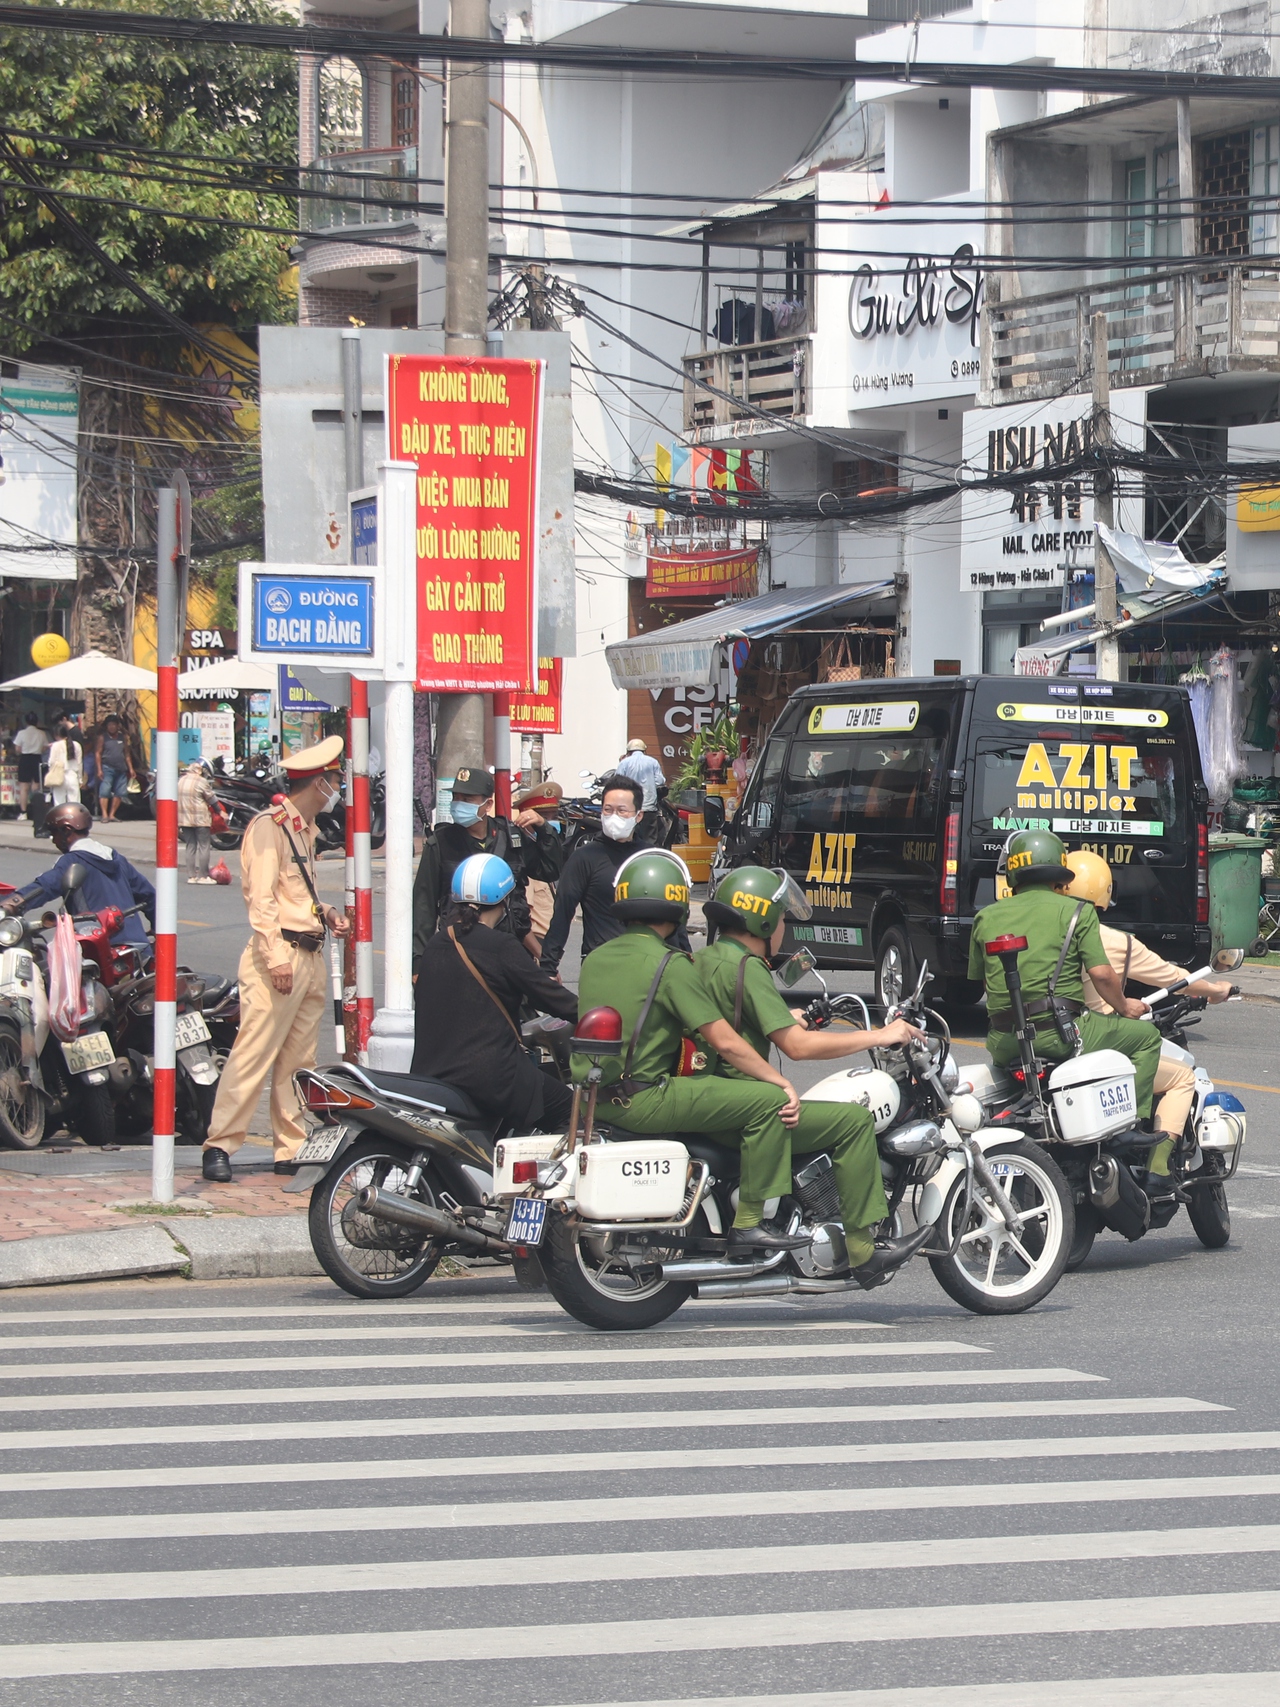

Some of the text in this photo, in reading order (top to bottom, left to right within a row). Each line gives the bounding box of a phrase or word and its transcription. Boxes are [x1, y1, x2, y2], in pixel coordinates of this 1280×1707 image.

[944, 243, 984, 348] Sp
[419, 365, 510, 408] KHÔNG DỪNG,
[872, 374, 888, 392] Hùng
[891, 372, 914, 389] Vương
[401, 417, 526, 464] ĐẬU XE, THỰC HIỆN
[417, 470, 510, 514] VIỆC MUA BÁN
[416, 522, 439, 560] ƯỚI
[442, 521, 478, 560] LÒNG
[480, 521, 520, 561] ĐƯỜNG
[1032, 532, 1060, 553] CARE
[978, 570, 994, 587] Hùng
[996, 570, 1016, 586] Vương
[1021, 567, 1031, 583] Hải
[1033, 568, 1050, 582] Châu
[300, 588, 358, 606] ĐƯỜNG
[426, 571, 506, 613] GÂY CẢN TRỞ
[266, 610, 361, 646] BẠCH ĐẰNG
[191, 630, 224, 648] SPA
[432, 627, 504, 664] GIAO THÔNG
[532, 703, 554, 722] THÔNG
[862, 708, 883, 726] 아지트
[1004, 706, 1015, 715] Ch
[1056, 708, 1115, 721] 다낭 아지트
[1016, 742, 1138, 790] AZIT
[1017, 789, 1137, 814] multiplex
[992, 816, 1131, 833] NAVER 다낭 아지트
[806, 833, 856, 884] AZIT
[1007, 851, 1033, 870] CSTT
[732, 891, 772, 917] CSTT
[806, 885, 852, 912] multiplex
[793, 926, 815, 941] NAVER
[1100, 1083, 1130, 1107] C.S.G.T
[1103, 1104, 1132, 1118] TRAFFIC POLICE
[622, 1160, 671, 1176] CS113
[516, 1199, 540, 1221] 43-A1
[509, 1221, 541, 1242] 000.67
